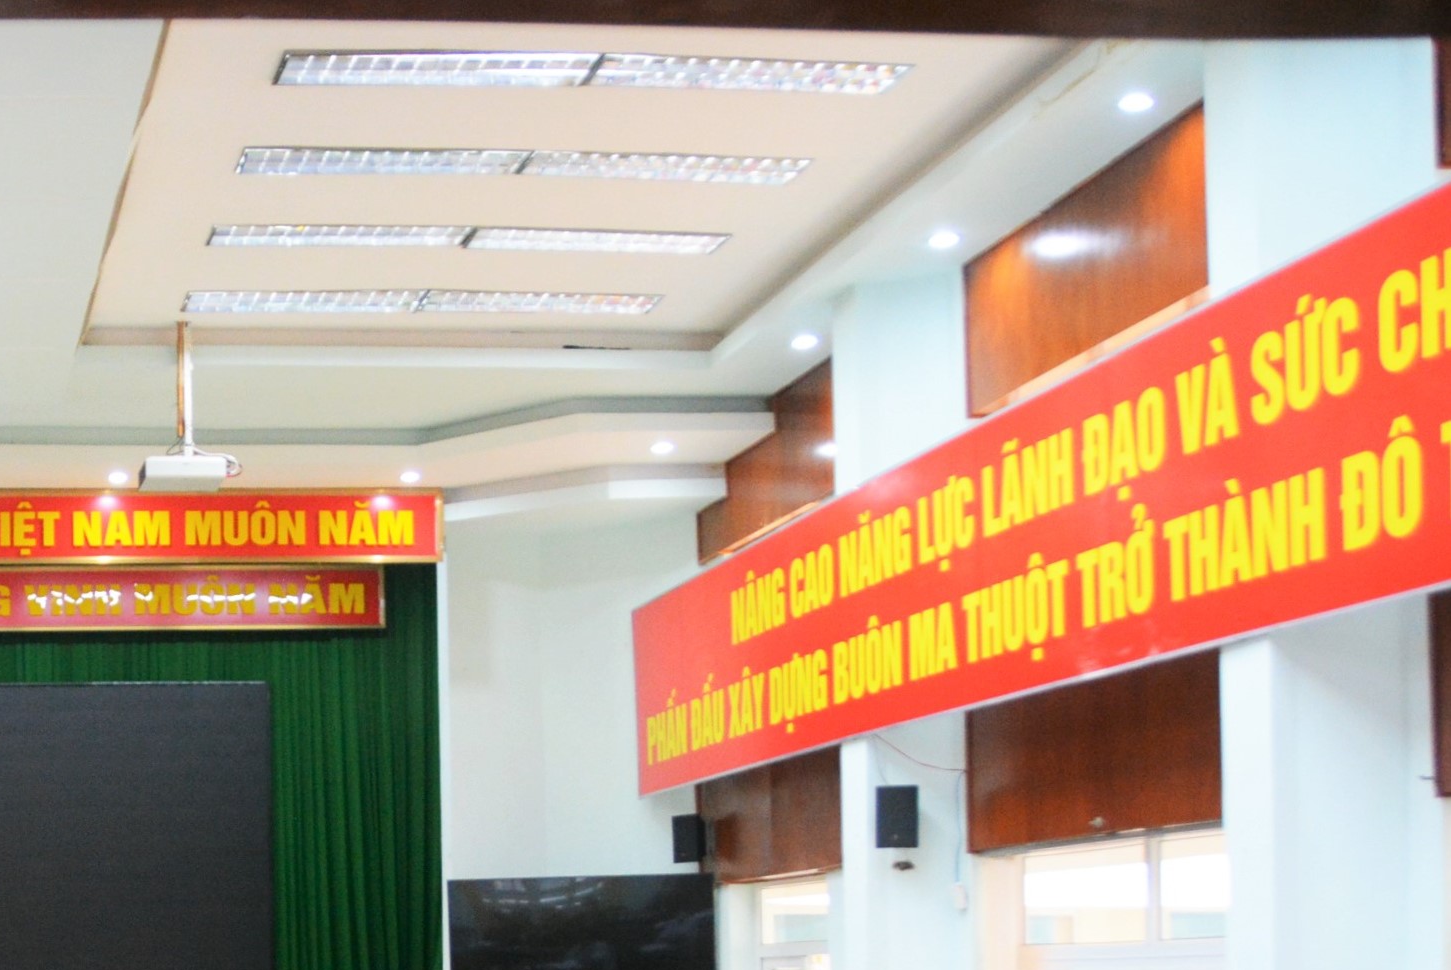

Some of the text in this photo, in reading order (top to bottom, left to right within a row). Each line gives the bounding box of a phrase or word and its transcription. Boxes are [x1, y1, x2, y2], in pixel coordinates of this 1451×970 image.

[72, 510, 172, 548] NAM
[184, 501, 307, 547] MUÔN
[318, 501, 416, 547] NĂM
[730, 567, 786, 645] NÂNG
[789, 543, 835, 618] CAO
[838, 506, 913, 598] NĂNG
[917, 475, 976, 572] LỰC
[981, 427, 1075, 538] LÃNH
[1081, 386, 1167, 502] ĐẠO
[1175, 337, 1240, 455] VÀ
[1250, 294, 1360, 425] SỨC
[23, 584, 122, 616] VINH
[134, 575, 256, 615] MUÔN
[268, 575, 365, 615] NĂM
[646, 688, 689, 766] PHẤN
[690, 672, 726, 752] ĐẤU
[728, 667, 765, 738] XÂY
[768, 651, 829, 734] DỰNG
[832, 615, 903, 705] BUÔN
[908, 601, 958, 681] MA
[961, 552, 1070, 663] THUỘT
[1075, 503, 1155, 628] TRỞ
[1162, 467, 1326, 602] THÀNH
[1339, 415, 1423, 551] ĐÔ
